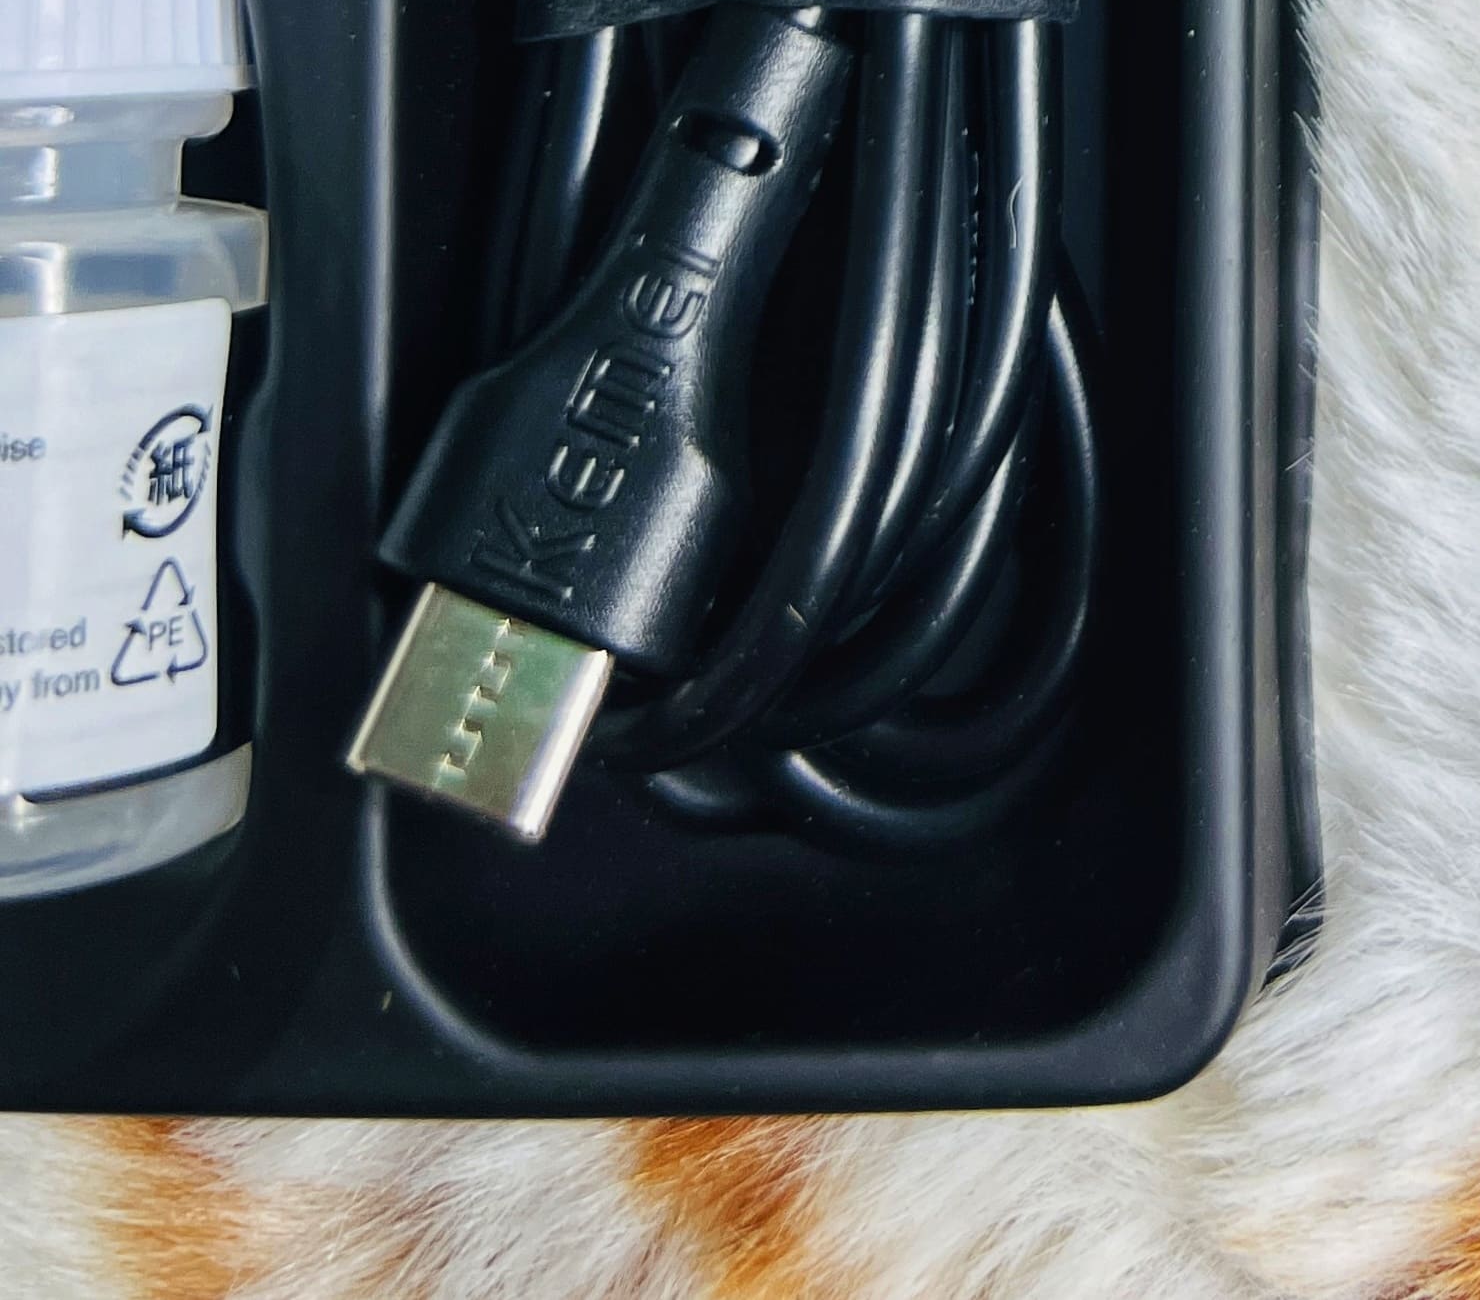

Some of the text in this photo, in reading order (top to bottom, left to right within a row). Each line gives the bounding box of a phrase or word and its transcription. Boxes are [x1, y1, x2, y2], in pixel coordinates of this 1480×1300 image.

[0, 432, 46, 461] ise
[149, 616, 184, 650] PE
[31, 669, 100, 700] from
